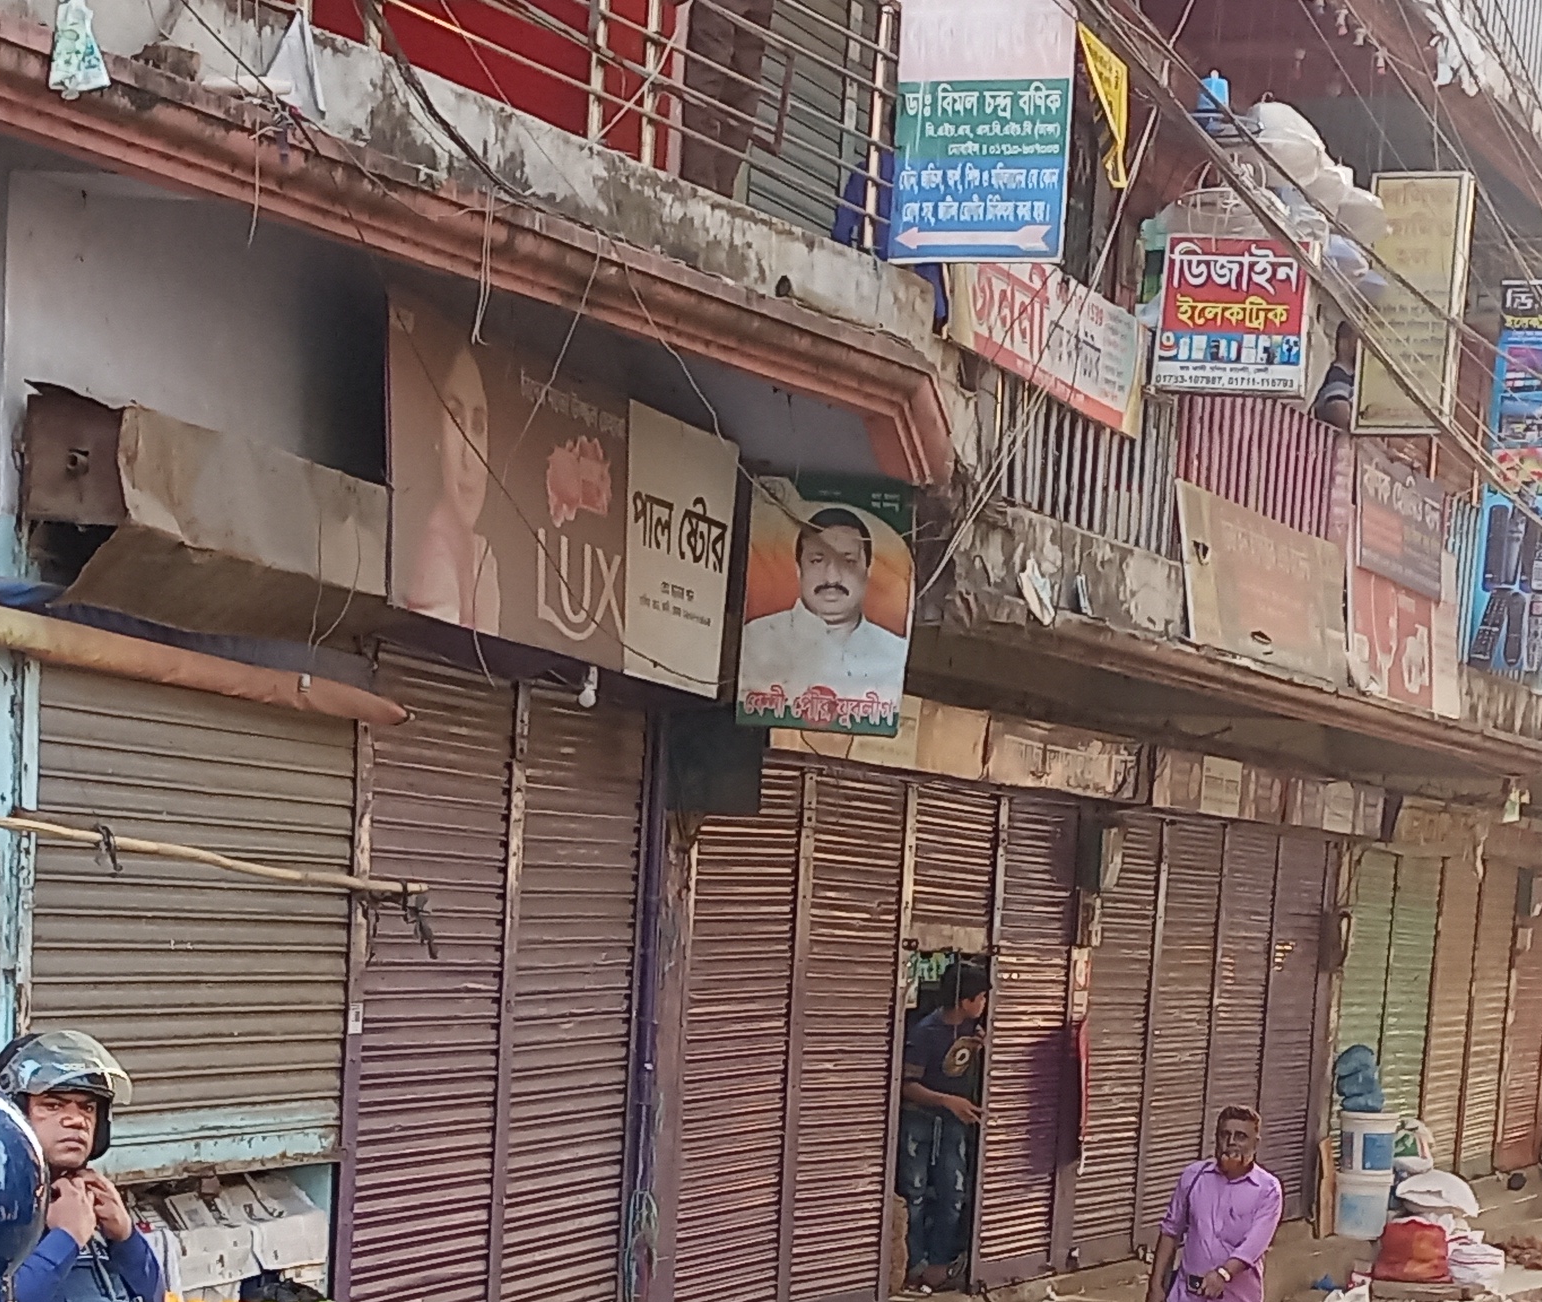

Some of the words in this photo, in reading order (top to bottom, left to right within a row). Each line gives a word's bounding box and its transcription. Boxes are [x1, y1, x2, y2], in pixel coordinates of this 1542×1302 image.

[904, 89, 933, 118] ডাঃ
[936, 82, 980, 118] বিমল
[982, 90, 1015, 120] চন্দ্র
[1017, 80, 1063, 117] বণিক
[1169, 241, 1299, 296] ডিজাইন
[632, 490, 675, 556] পাল
[678, 497, 729, 574] ষ্টোর
[536, 527, 626, 643] LUX
